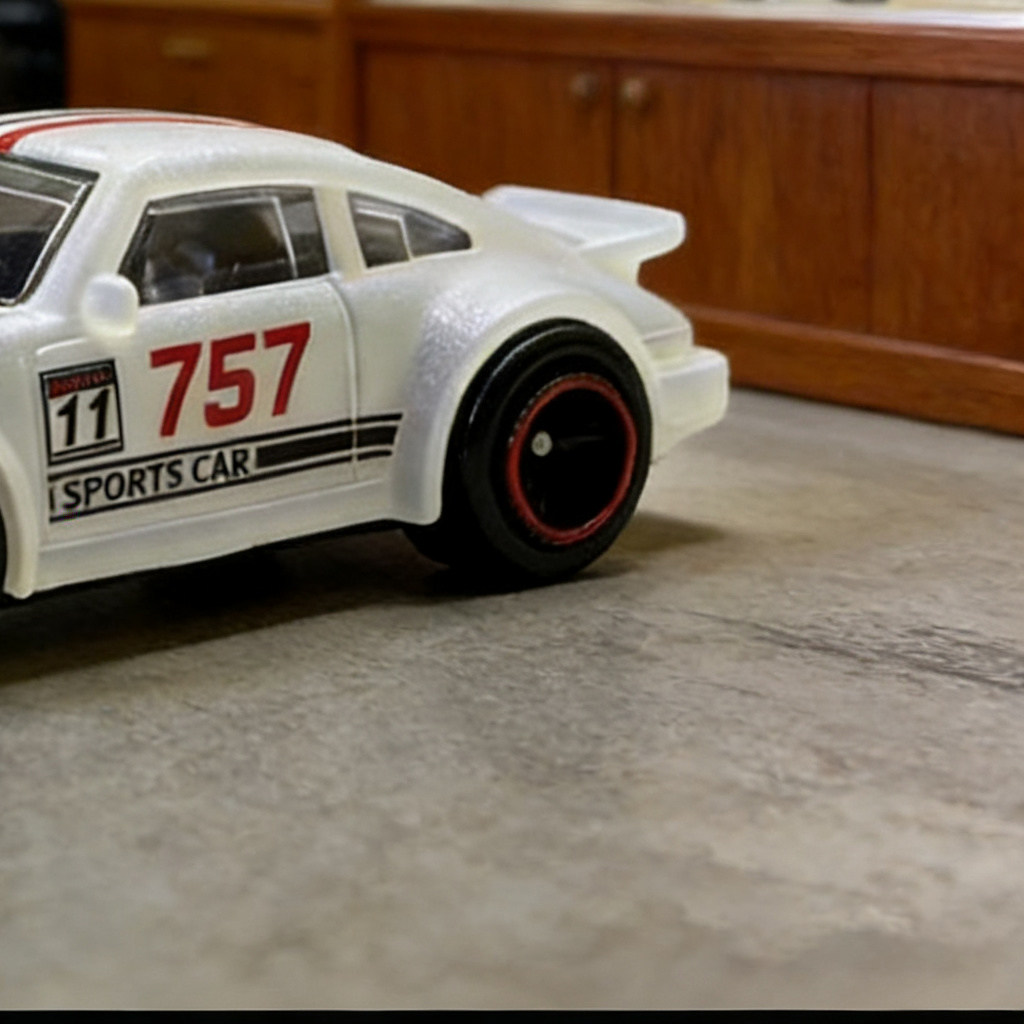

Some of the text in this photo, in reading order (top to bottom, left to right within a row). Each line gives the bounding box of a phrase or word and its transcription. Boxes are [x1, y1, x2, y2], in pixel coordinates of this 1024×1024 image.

[149, 321, 311, 438] 757
[57, 387, 111, 447] 11
[63, 448, 251, 511] SPORTS CAR
